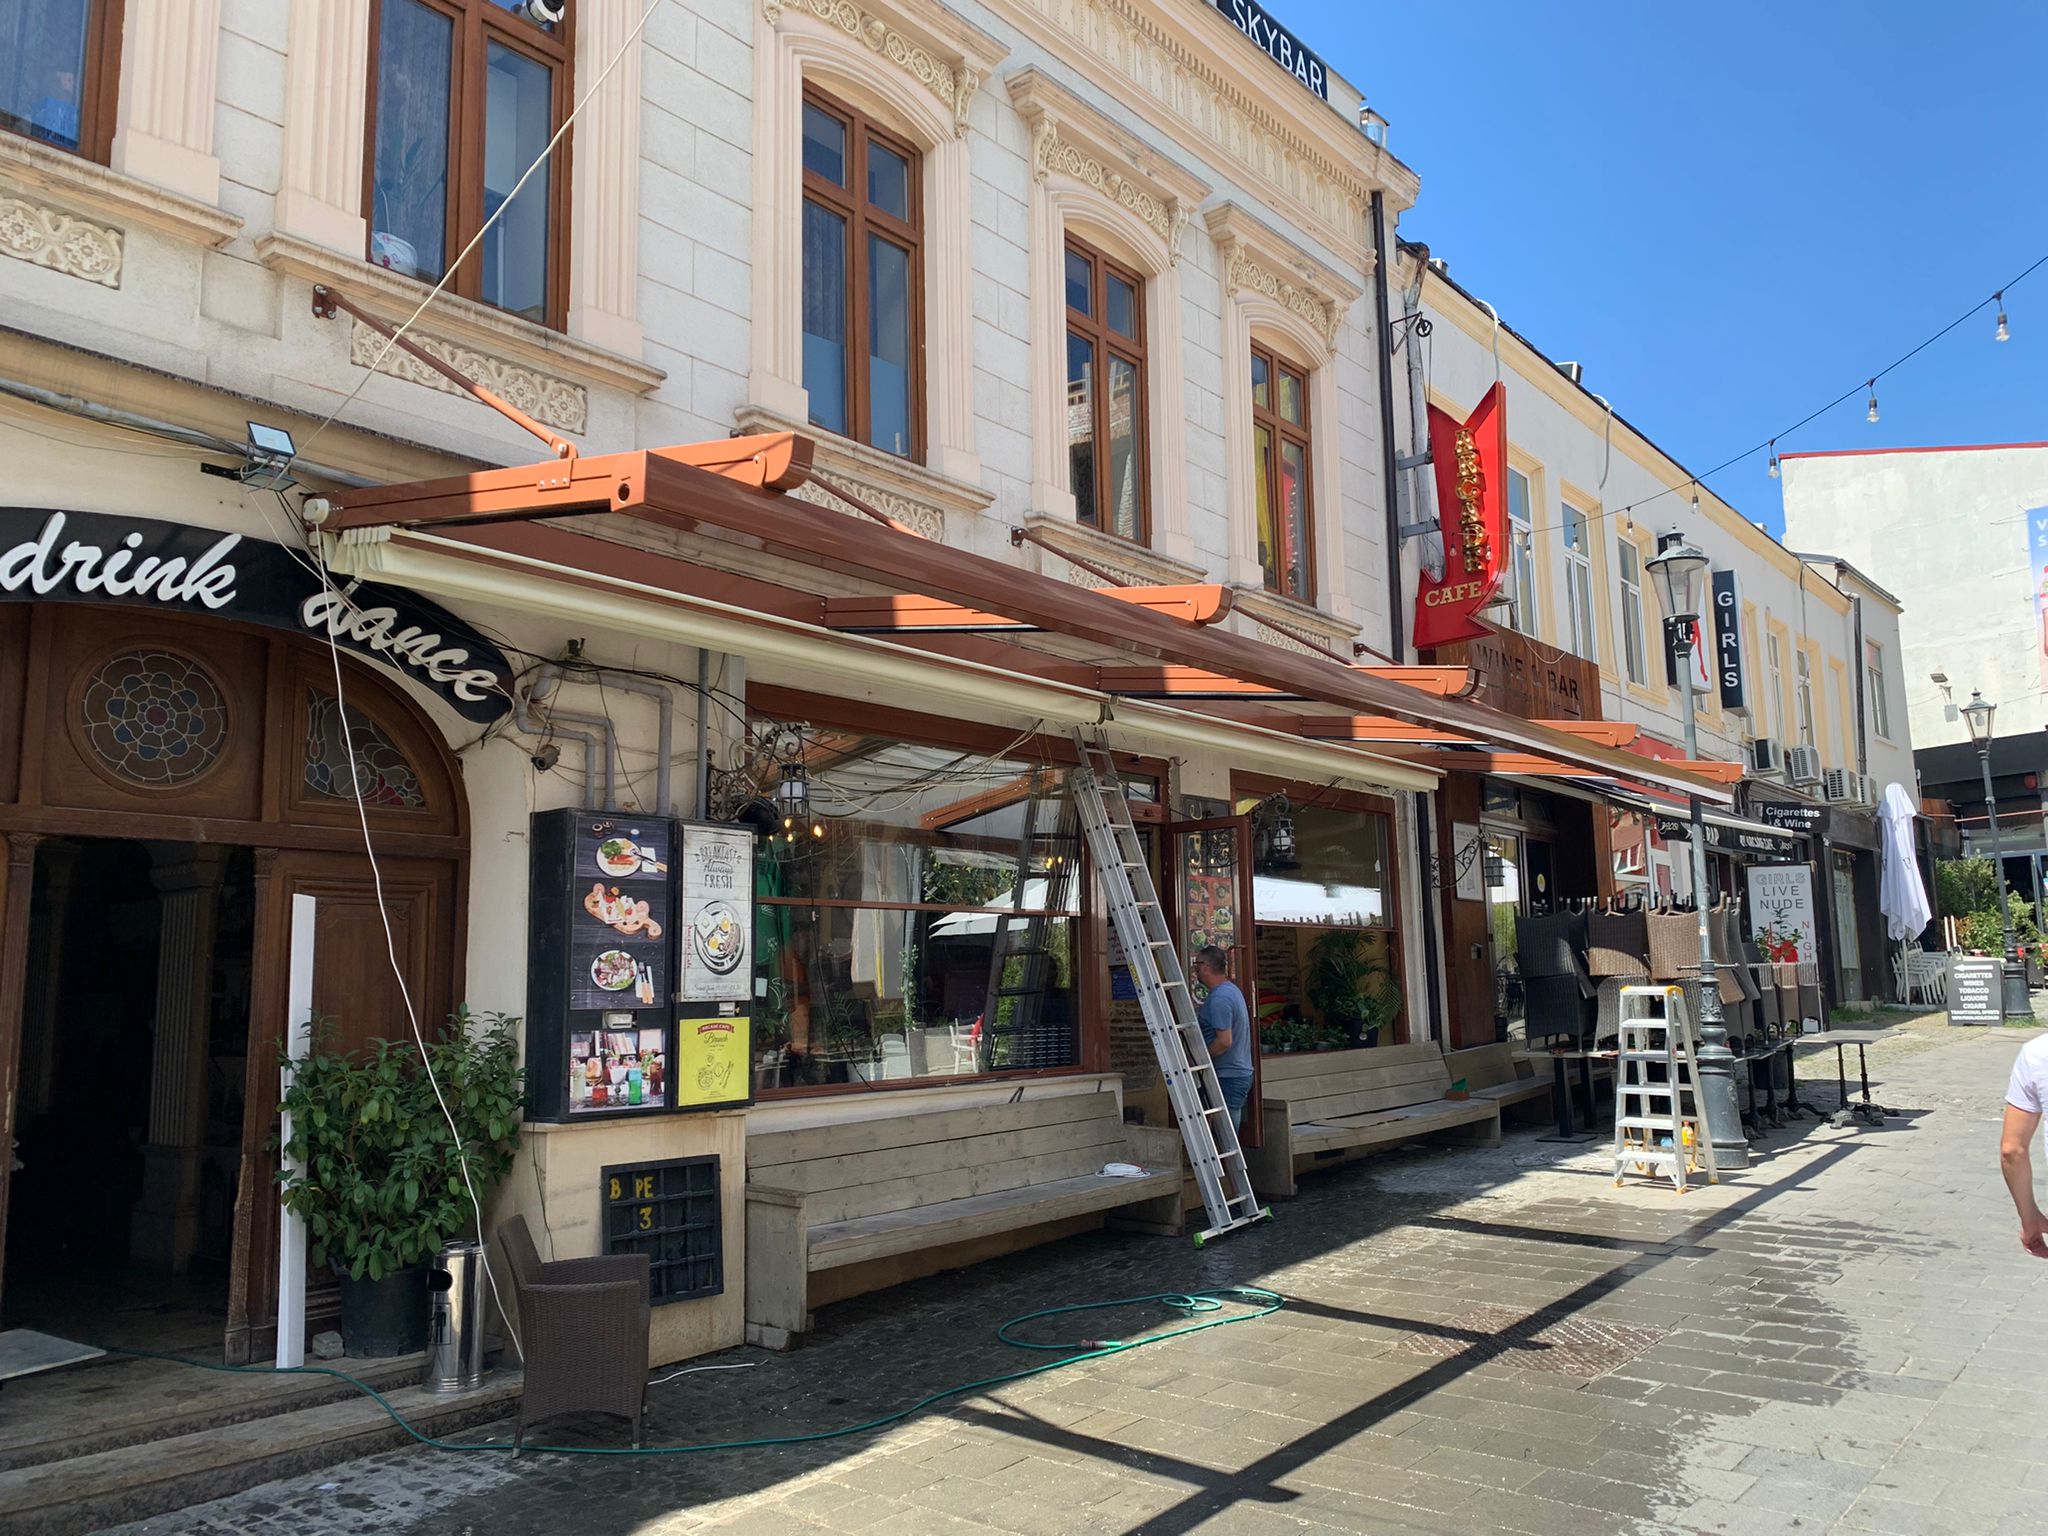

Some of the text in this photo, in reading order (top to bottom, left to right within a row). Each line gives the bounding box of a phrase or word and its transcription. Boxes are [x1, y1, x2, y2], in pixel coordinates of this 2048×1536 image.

[1232, 0, 1323, 98] SKYBAR
[1455, 427, 1487, 573] ARCADE
[2036, 518, 2048, 531] V
[0, 511, 242, 609] drink
[1424, 580, 1483, 608] CAFE
[303, 577, 500, 703] dance
[1717, 591, 1739, 688] GIRLS
[1475, 643, 1525, 682] WINE
[1546, 669, 1579, 701] BAR
[1766, 806, 1820, 818] Cigarettes
[1773, 818, 1812, 829] & Wine
[699, 844, 738, 864] BREAKFAST
[704, 874, 733, 889] FRESH
[1755, 872, 1806, 885] GIRLS
[1762, 885, 1800, 897] LIVE
[1760, 898, 1805, 910] NUDE
[1801, 920, 1812, 961] NIGH
[609, 1175, 655, 1200] B PE
[639, 1206, 654, 1230] 3
